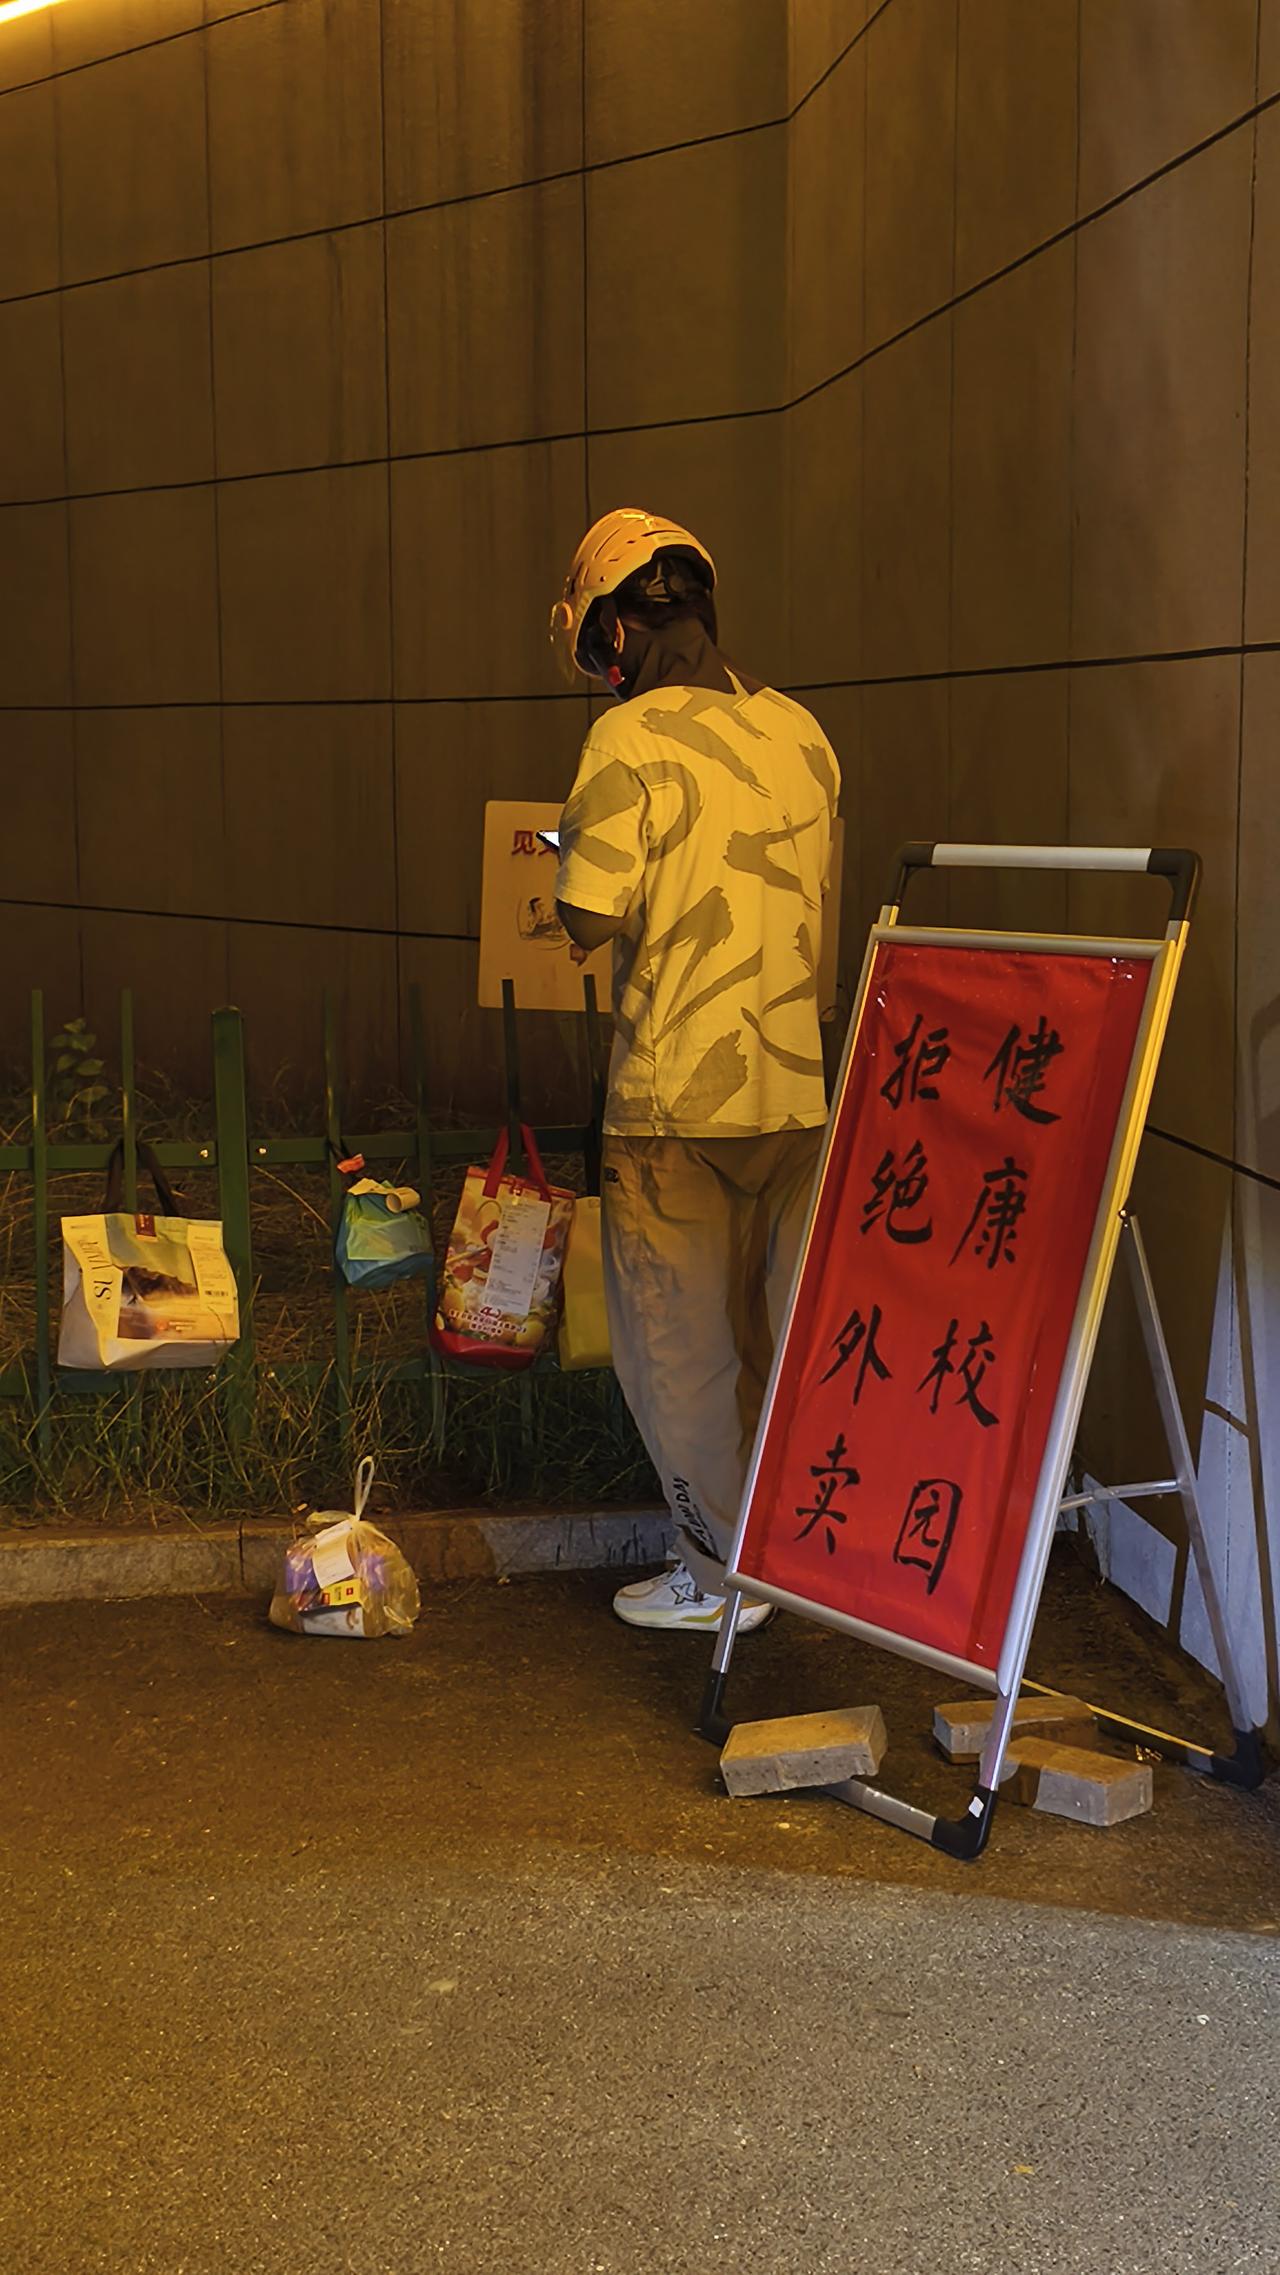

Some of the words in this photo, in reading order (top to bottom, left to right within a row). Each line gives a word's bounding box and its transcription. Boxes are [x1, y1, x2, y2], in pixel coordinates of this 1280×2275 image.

[793, 1014, 951, 1555] 拒绝外卖
[892, 1016, 1064, 1596] 健康校园
